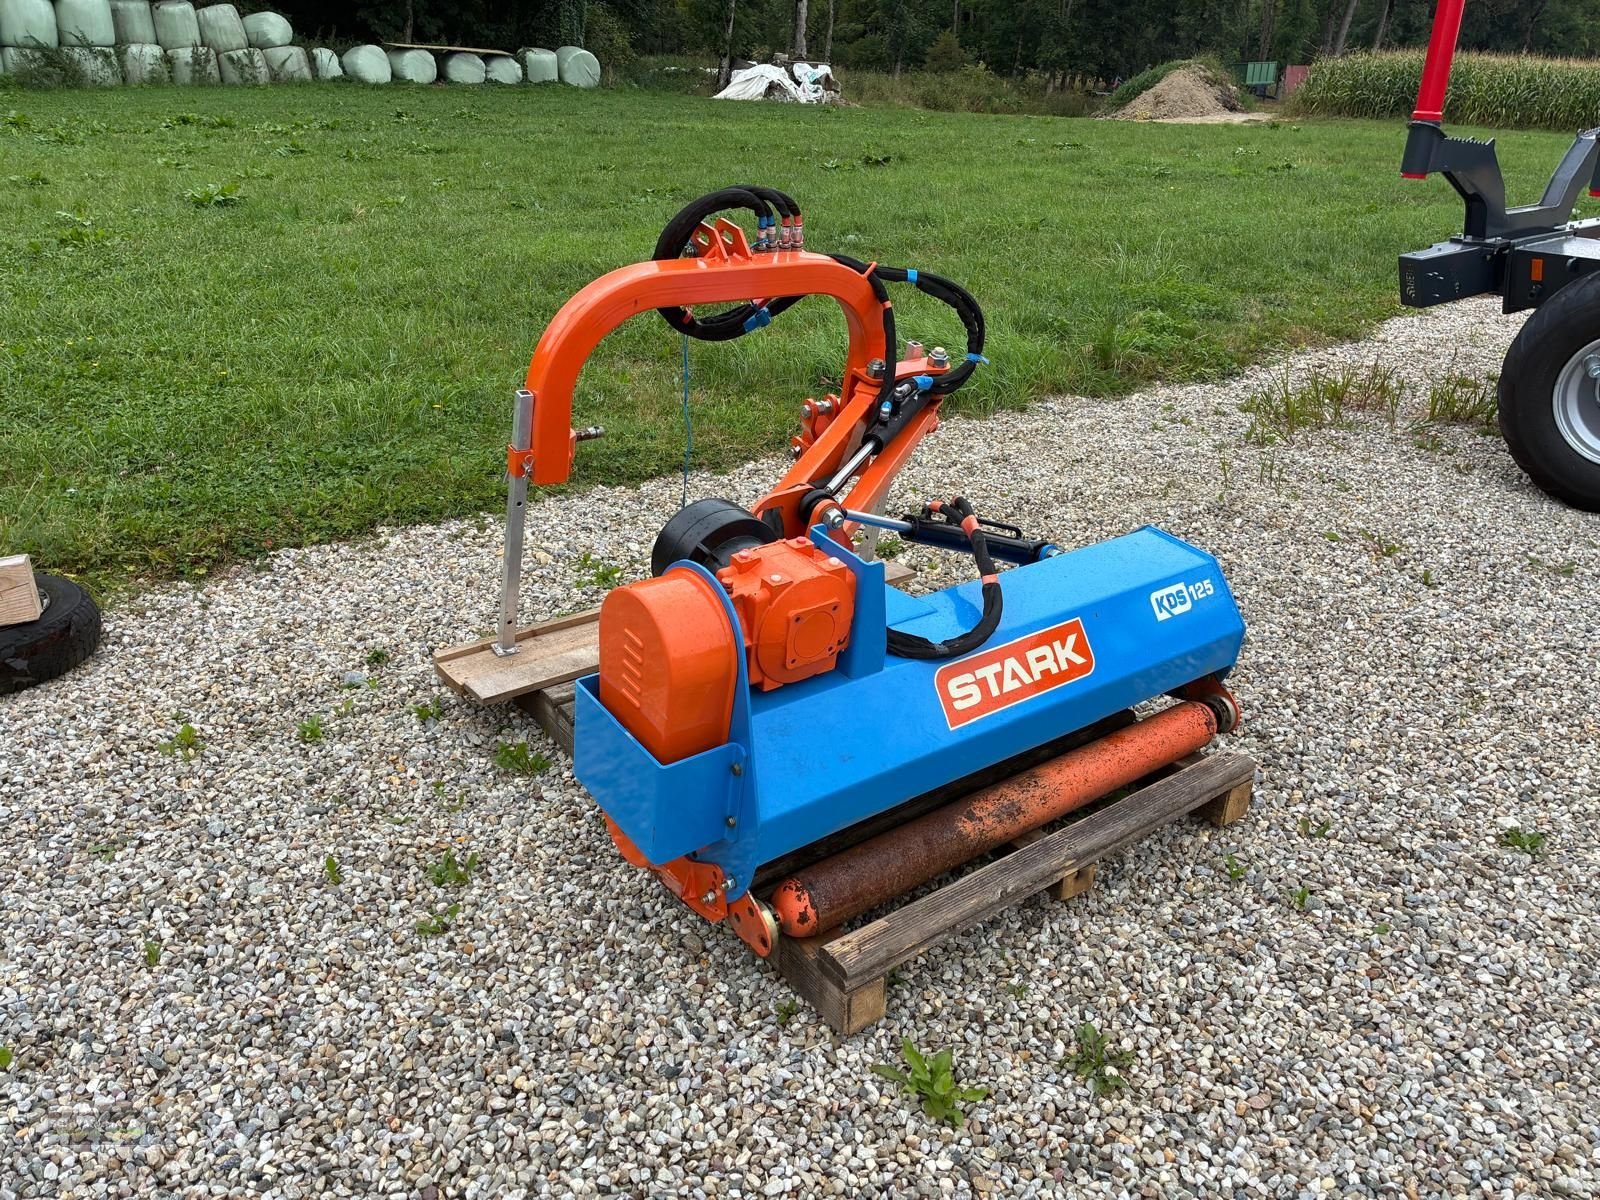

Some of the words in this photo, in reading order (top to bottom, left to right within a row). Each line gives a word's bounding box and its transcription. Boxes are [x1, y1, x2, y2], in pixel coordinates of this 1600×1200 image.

[1154, 588, 1189, 617] KDS
[1188, 579, 1214, 601] 125
[947, 633, 1087, 711] STARK
